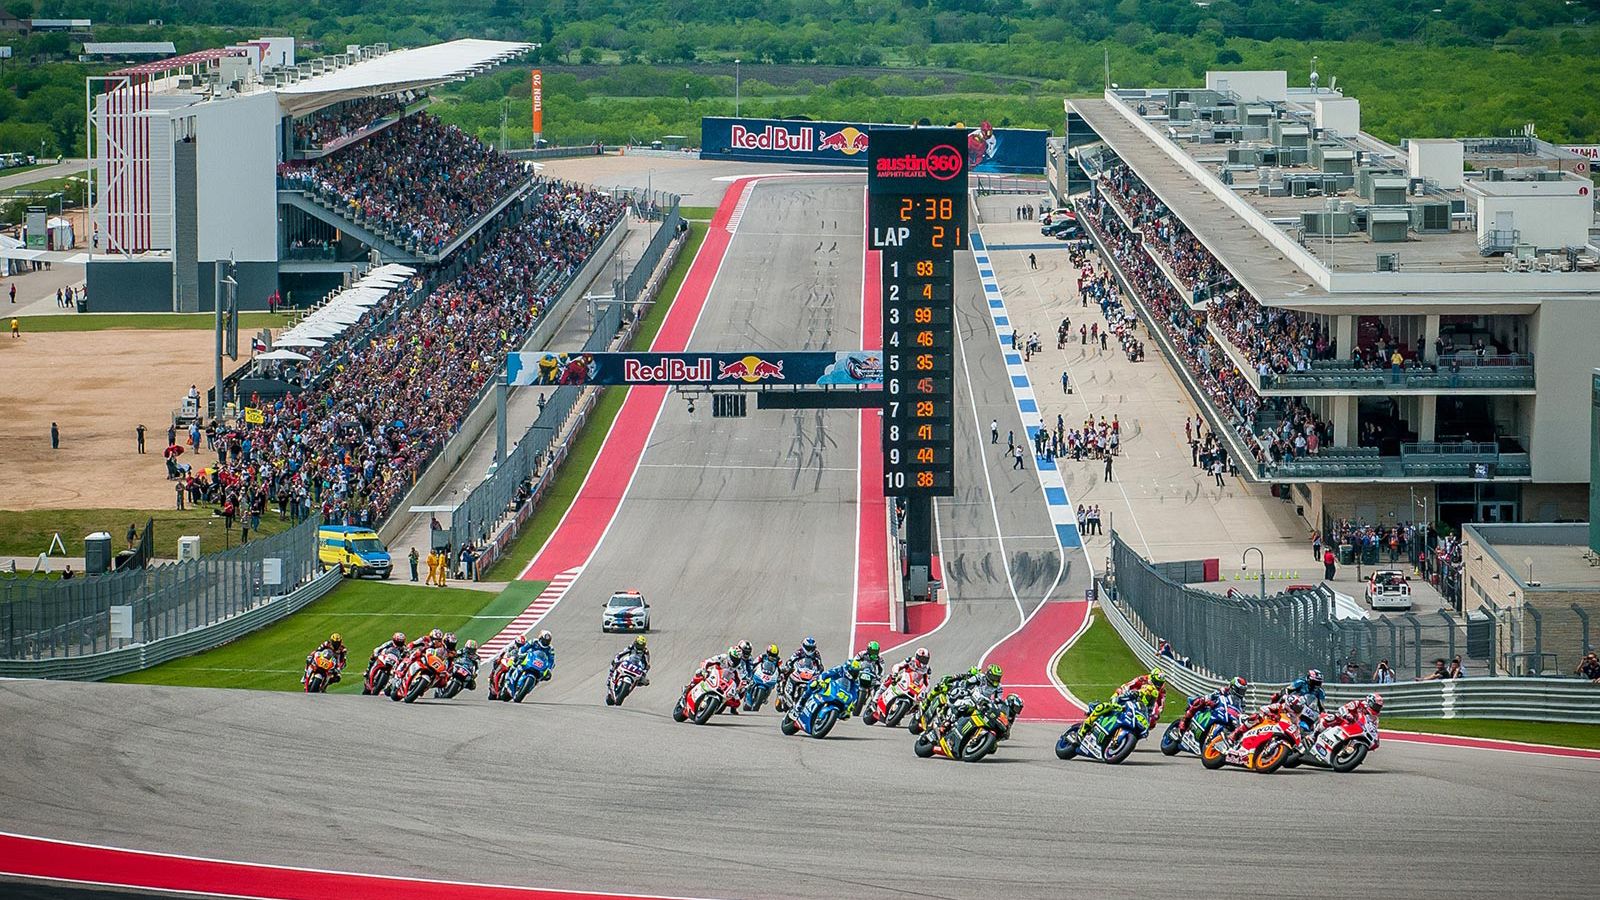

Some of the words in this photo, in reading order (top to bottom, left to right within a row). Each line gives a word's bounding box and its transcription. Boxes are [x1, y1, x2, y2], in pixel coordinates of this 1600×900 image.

[533, 74, 542, 86] 20
[533, 88, 542, 112] TURN
[731, 125, 773, 150] Red
[773, 127, 814, 152] Bull
[874, 227, 910, 246] LAP
[890, 261, 898, 278] 1
[916, 261, 934, 277] 93
[889, 285, 900, 301] 2
[923, 284, 932, 300] 4
[889, 308, 900, 324] 3
[915, 307, 932, 323] 99
[889, 331, 900, 348] 4
[916, 331, 934, 347] 46
[624, 357, 669, 382] Red
[669, 357, 712, 382] Bull
[889, 355, 900, 371] 5
[916, 355, 934, 370] 35
[889, 378, 900, 395] 6
[917, 378, 933, 393] 45
[889, 402, 900, 418] 7
[916, 402, 934, 417] 29
[889, 425, 900, 441] 8
[918, 425, 932, 441] 41
[890, 448, 900, 465] 9
[917, 448, 934, 464] 44
[885, 471, 905, 488] 10
[917, 472, 934, 487] 38
